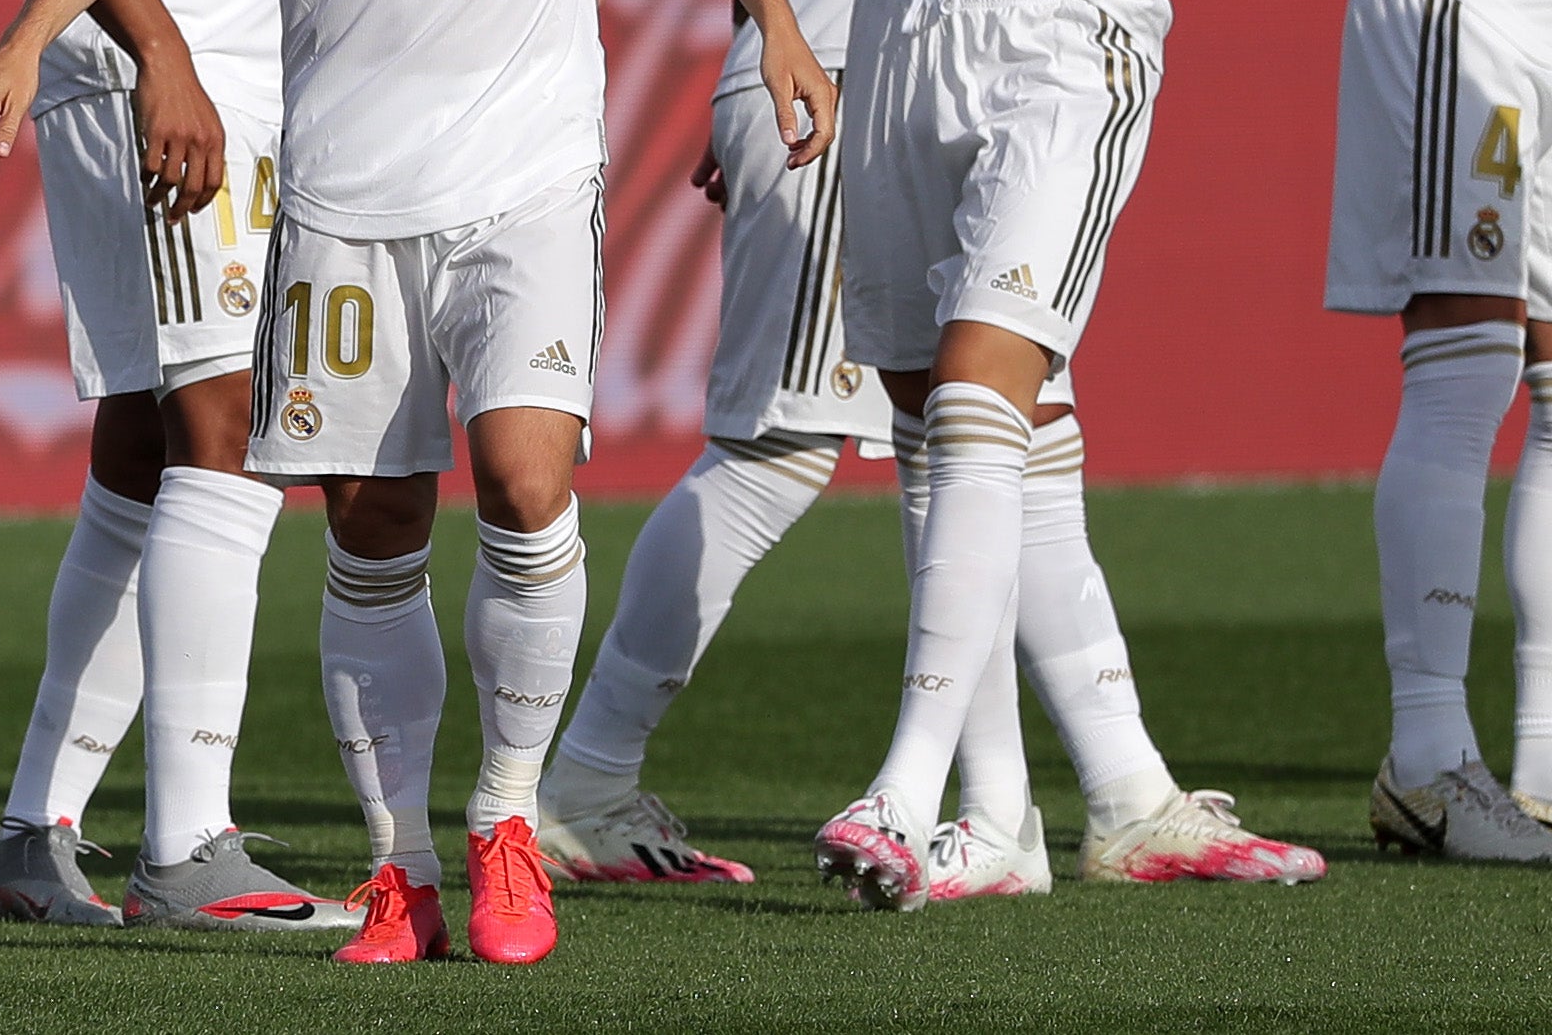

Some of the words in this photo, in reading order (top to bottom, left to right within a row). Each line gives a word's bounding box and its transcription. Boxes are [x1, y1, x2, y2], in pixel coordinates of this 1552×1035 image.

[1471, 104, 1523, 200] 4
[990, 279, 1038, 301] adidas
[282, 280, 374, 380] 10
[529, 357, 577, 376] adidas
